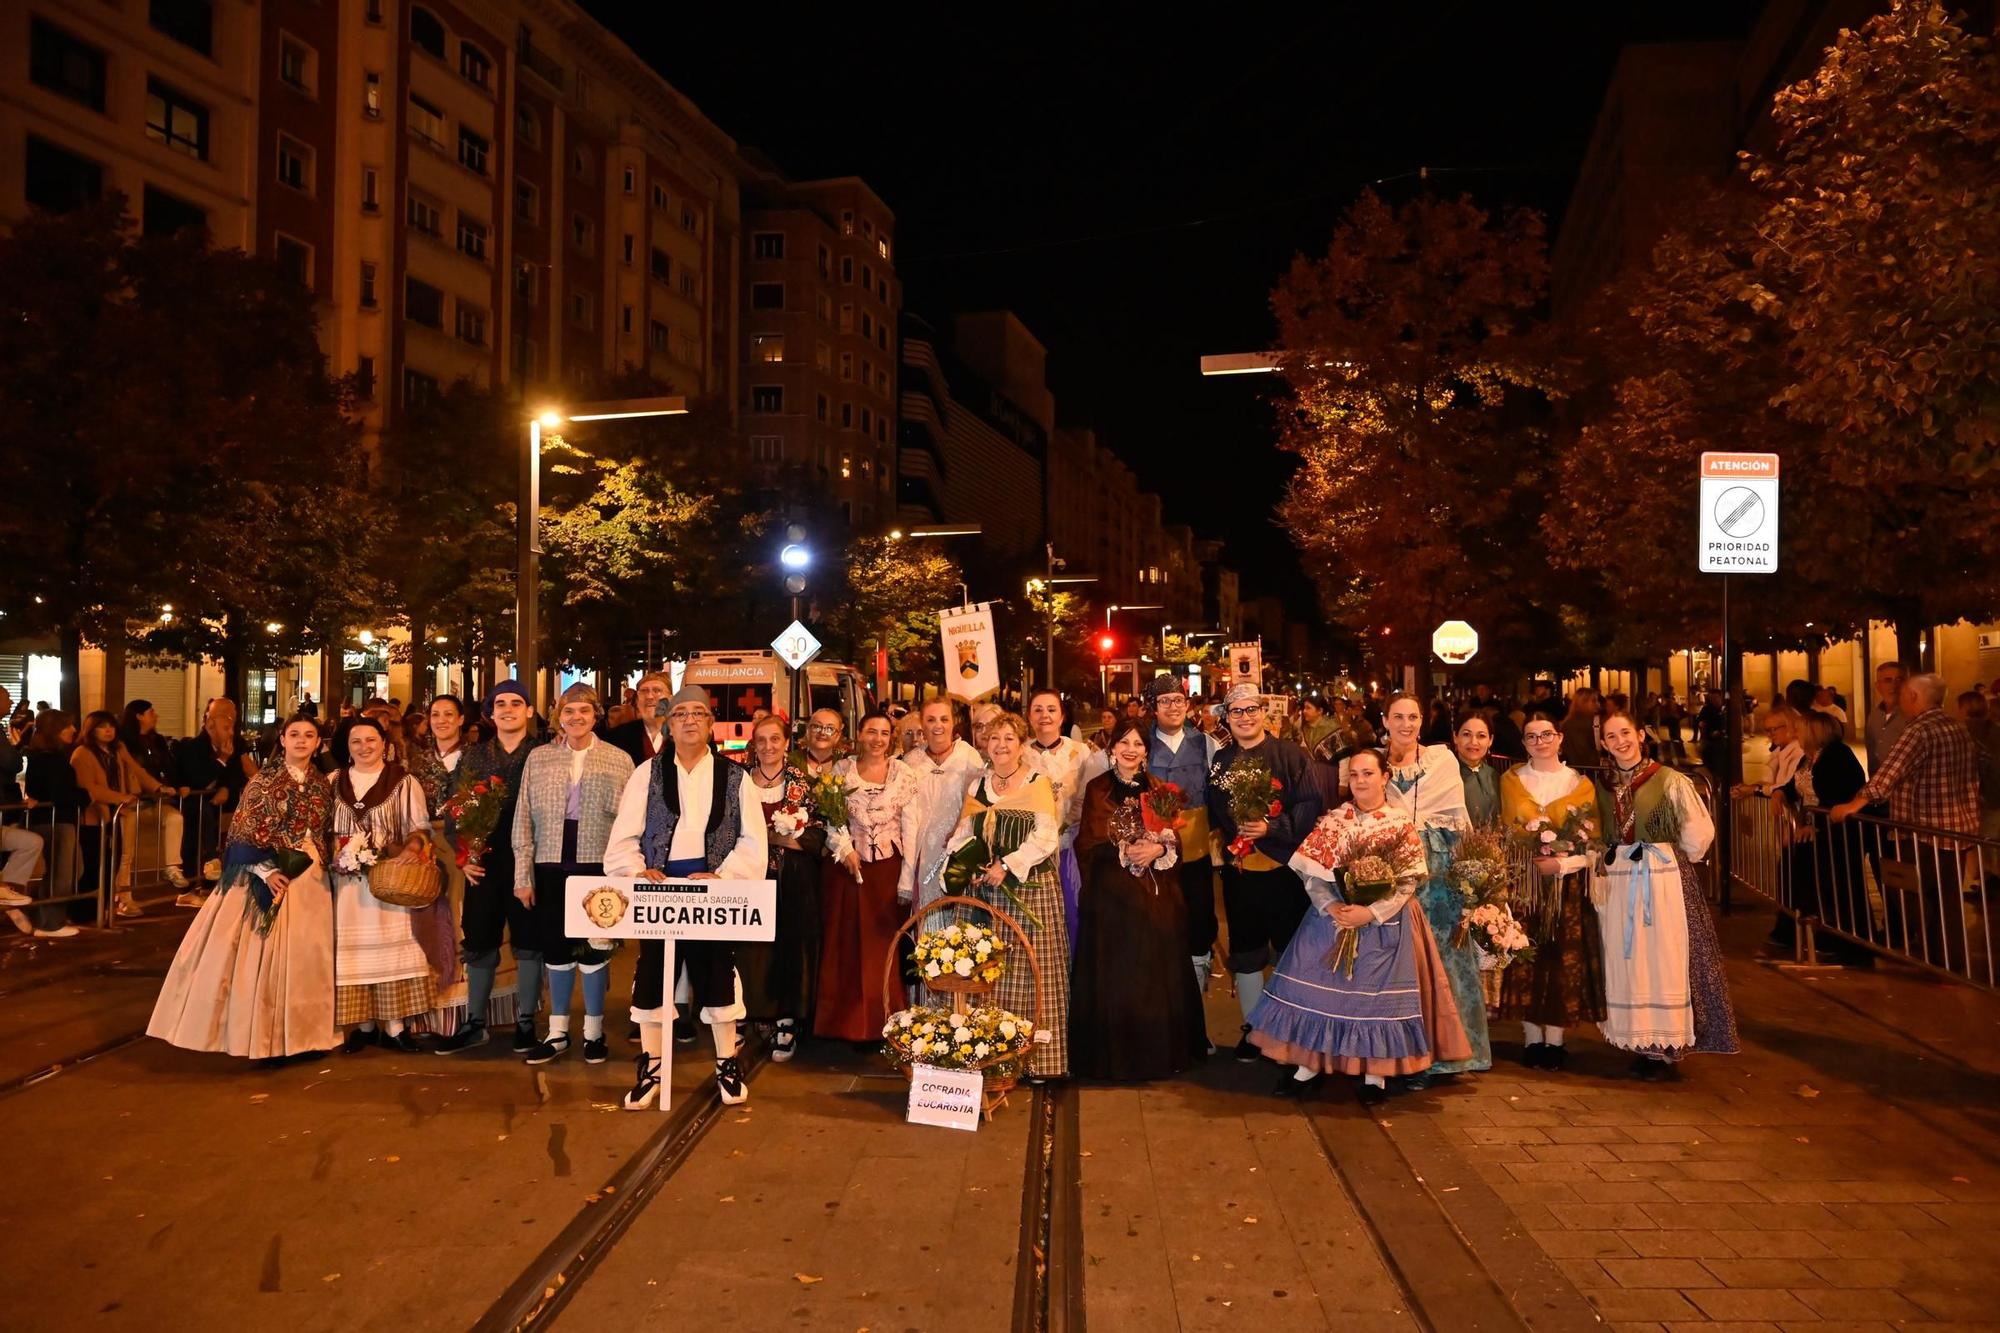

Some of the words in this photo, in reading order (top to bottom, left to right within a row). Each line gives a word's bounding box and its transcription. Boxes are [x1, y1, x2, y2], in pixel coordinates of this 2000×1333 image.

[1710, 461, 1770, 471] ATENCIÓN
[1708, 542, 1770, 552] PRIORIDAD
[1709, 556, 1769, 566] PEATONAL
[695, 667, 765, 678] AMBULANCIA
[686, 895, 697, 904] DE
[699, 896, 709, 905] LA
[710, 896, 749, 905] SAGRADA
[633, 904, 763, 926] EUCARISTÍA
